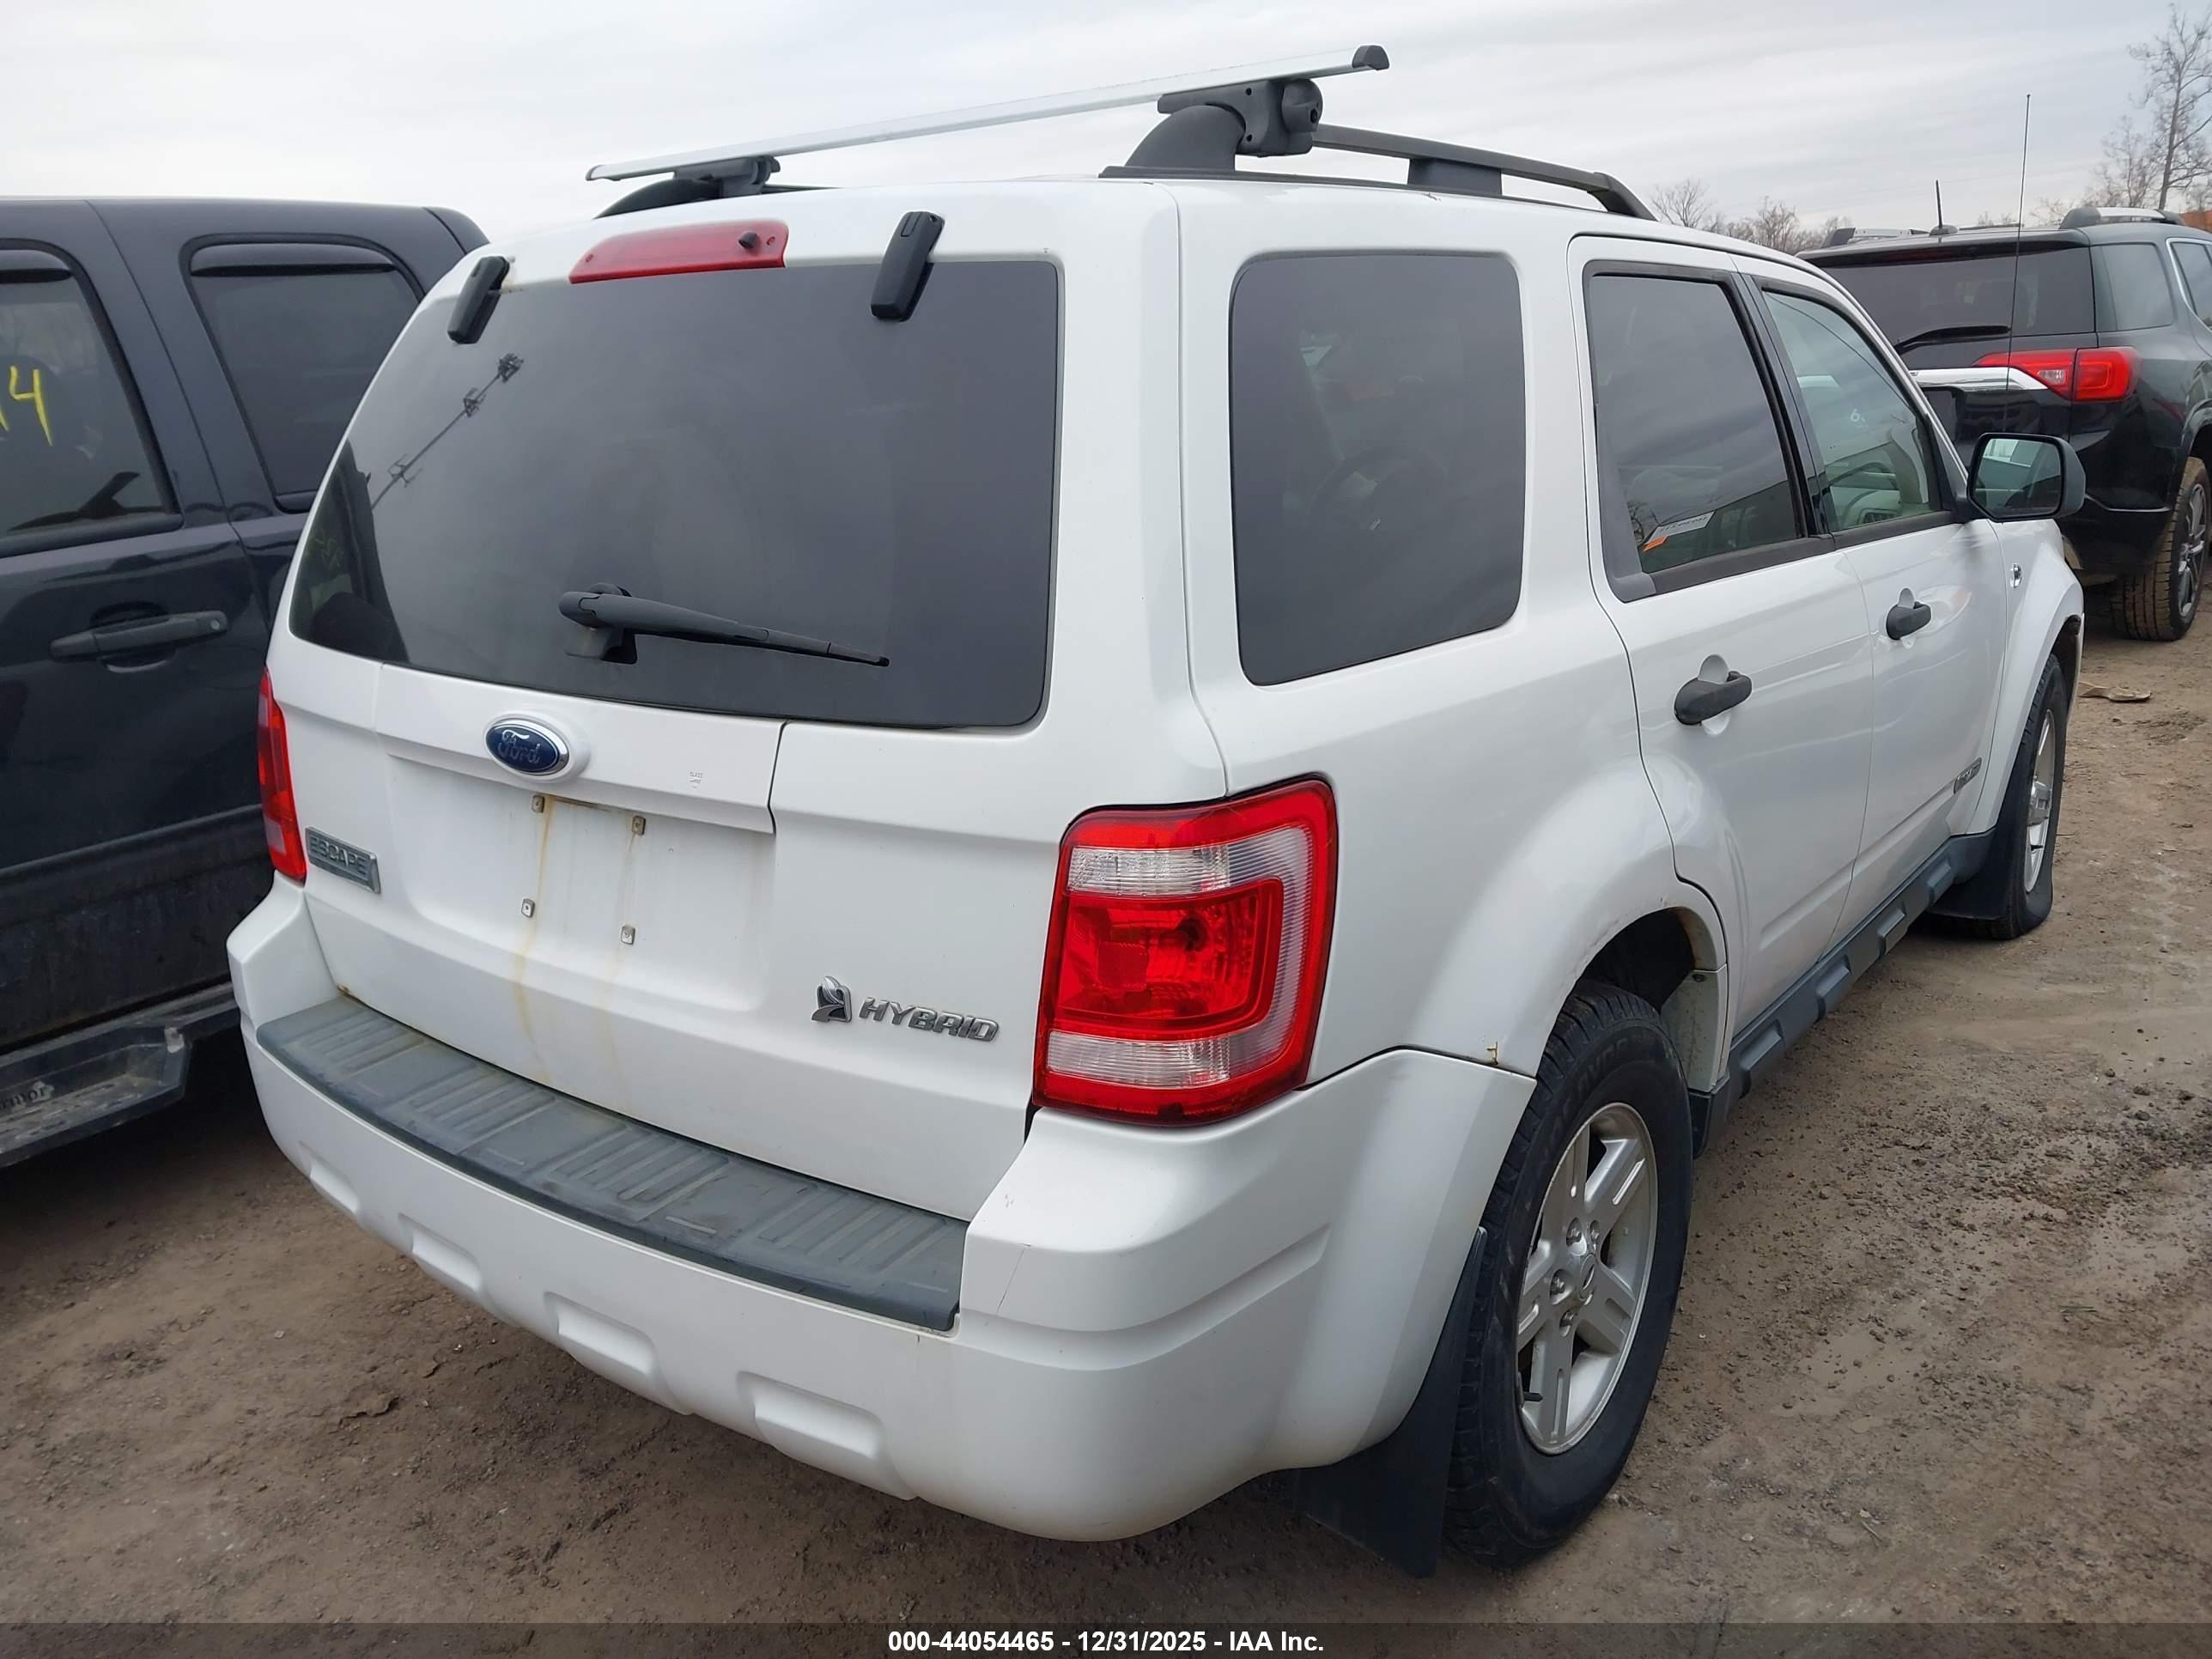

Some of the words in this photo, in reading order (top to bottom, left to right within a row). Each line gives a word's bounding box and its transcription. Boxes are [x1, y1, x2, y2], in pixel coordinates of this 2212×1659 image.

[0, 365, 53, 447] 4
[497, 729, 543, 765] Ford
[308, 835, 371, 877] ESCAPE
[858, 996, 1000, 1042] HYBRID
